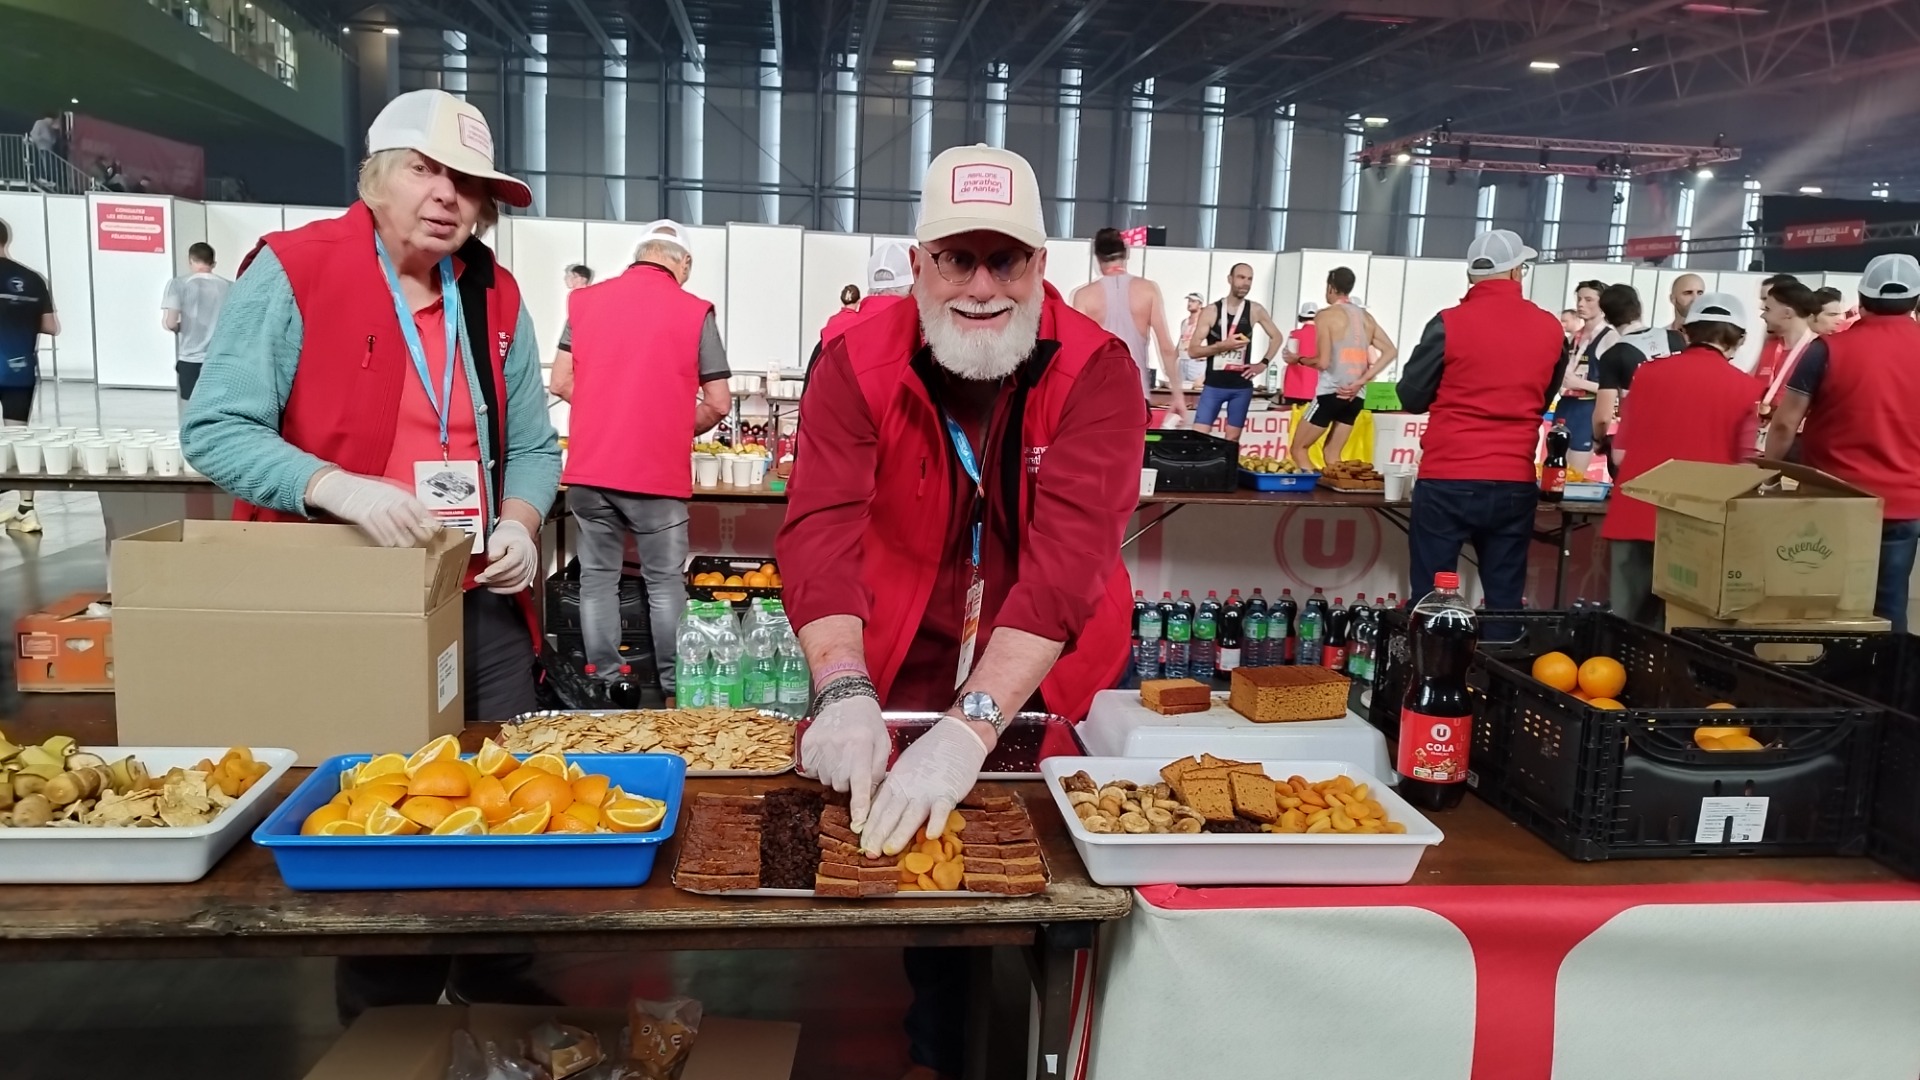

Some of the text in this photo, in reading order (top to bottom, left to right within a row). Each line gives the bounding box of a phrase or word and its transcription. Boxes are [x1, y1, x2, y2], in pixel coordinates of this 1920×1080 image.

[963, 178, 1003, 189] marathon
[1303, 518, 1356, 569] U
[1776, 537, 1833, 561] Greenday
[1727, 570, 1742, 579] 50
[1437, 729, 1447, 737] U
[1426, 743, 1454, 752] COLA
